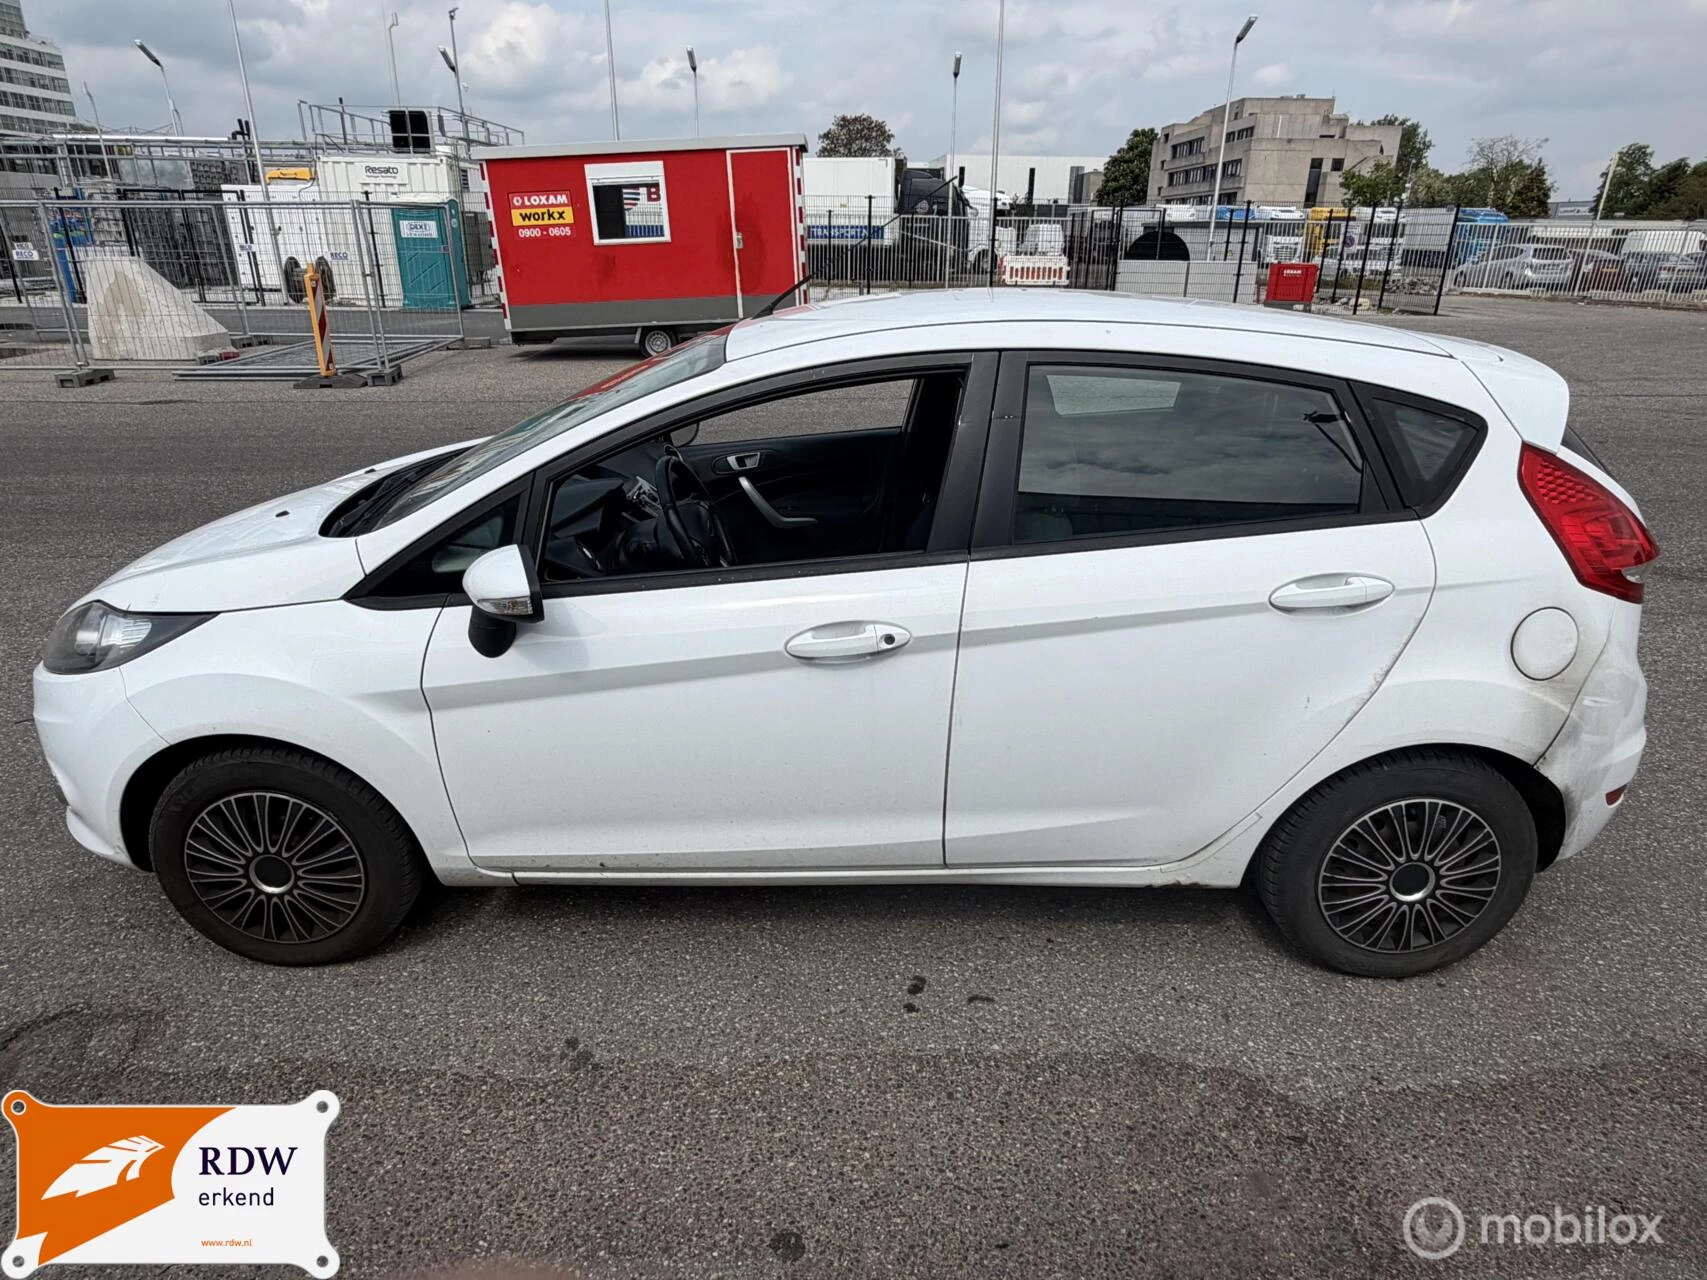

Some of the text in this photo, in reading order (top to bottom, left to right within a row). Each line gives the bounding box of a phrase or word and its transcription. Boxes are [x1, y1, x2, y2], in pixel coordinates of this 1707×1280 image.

[364, 165, 399, 175] Resato
[526, 194, 568, 205] LOXAM
[519, 209, 565, 222] workx
[518, 228, 541, 238] 0900
[549, 226, 571, 236] 0605
